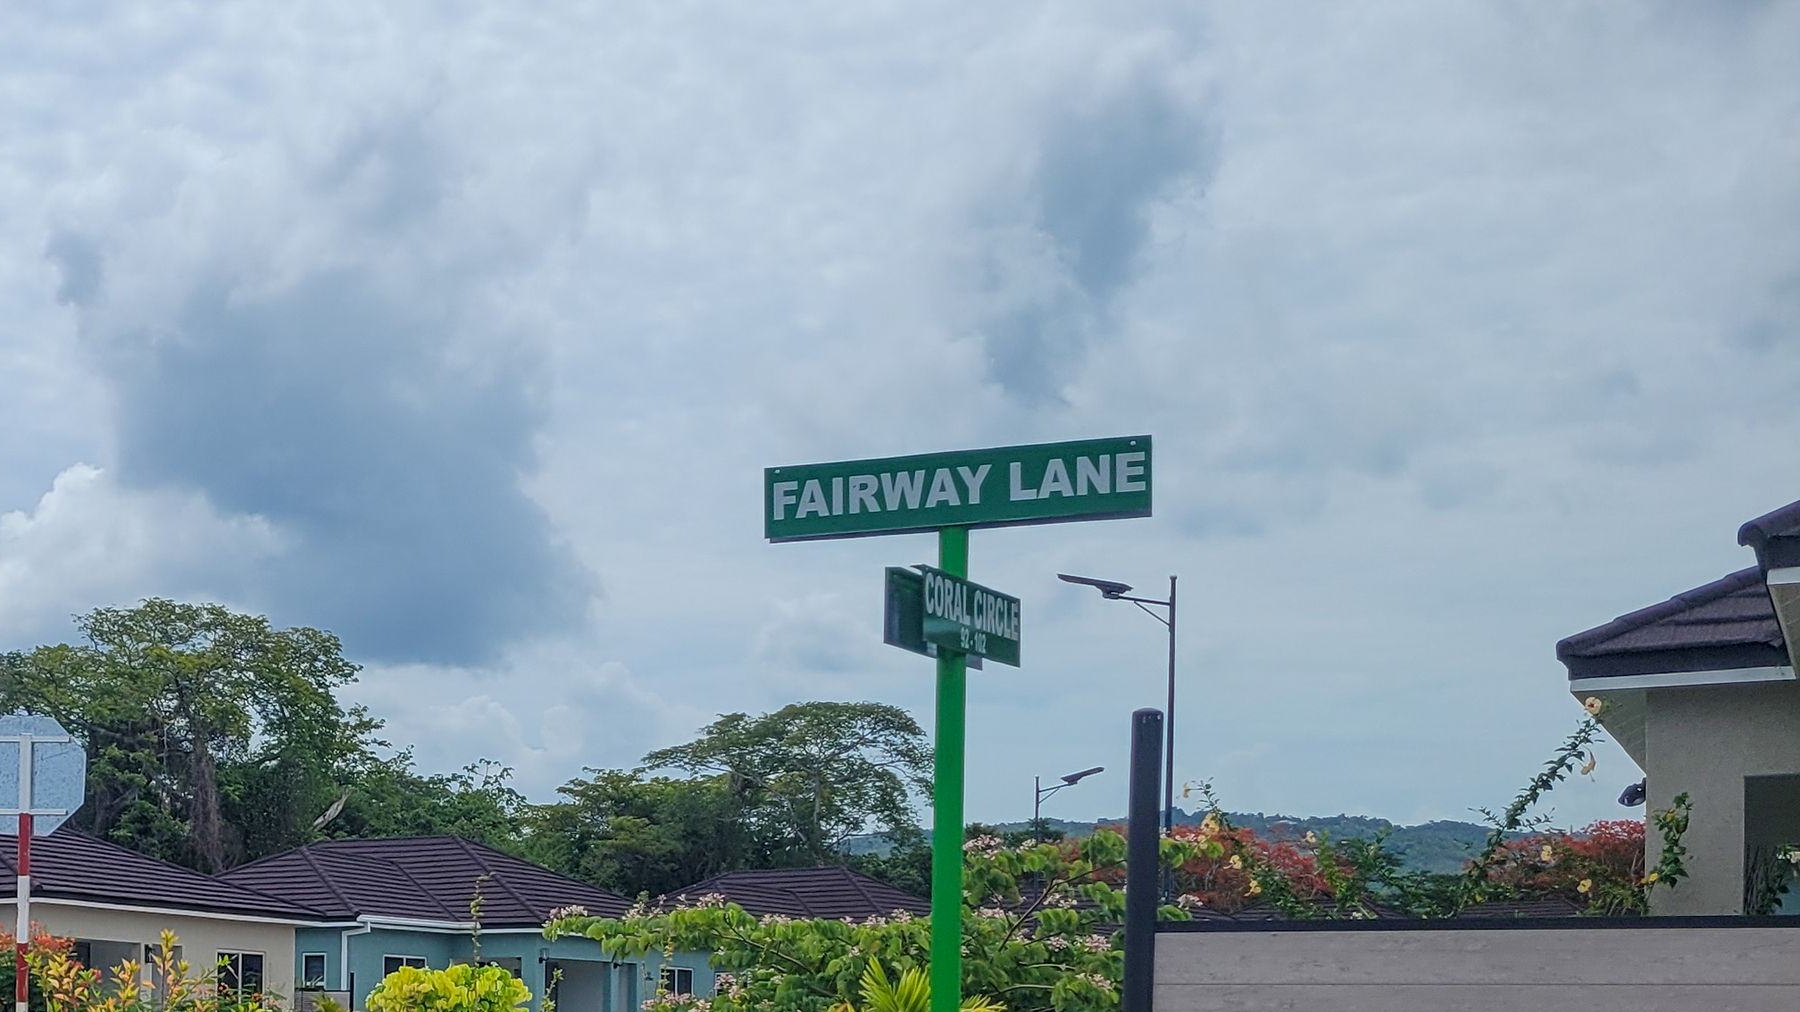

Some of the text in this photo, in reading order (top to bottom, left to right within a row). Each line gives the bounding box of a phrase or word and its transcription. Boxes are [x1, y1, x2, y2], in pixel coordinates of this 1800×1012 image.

[772, 451, 1147, 521] FAIRWAY LANE
[925, 572, 1019, 641] CORAL CIRCLE
[960, 627, 970, 649] 92
[974, 631, 987, 654] 102
